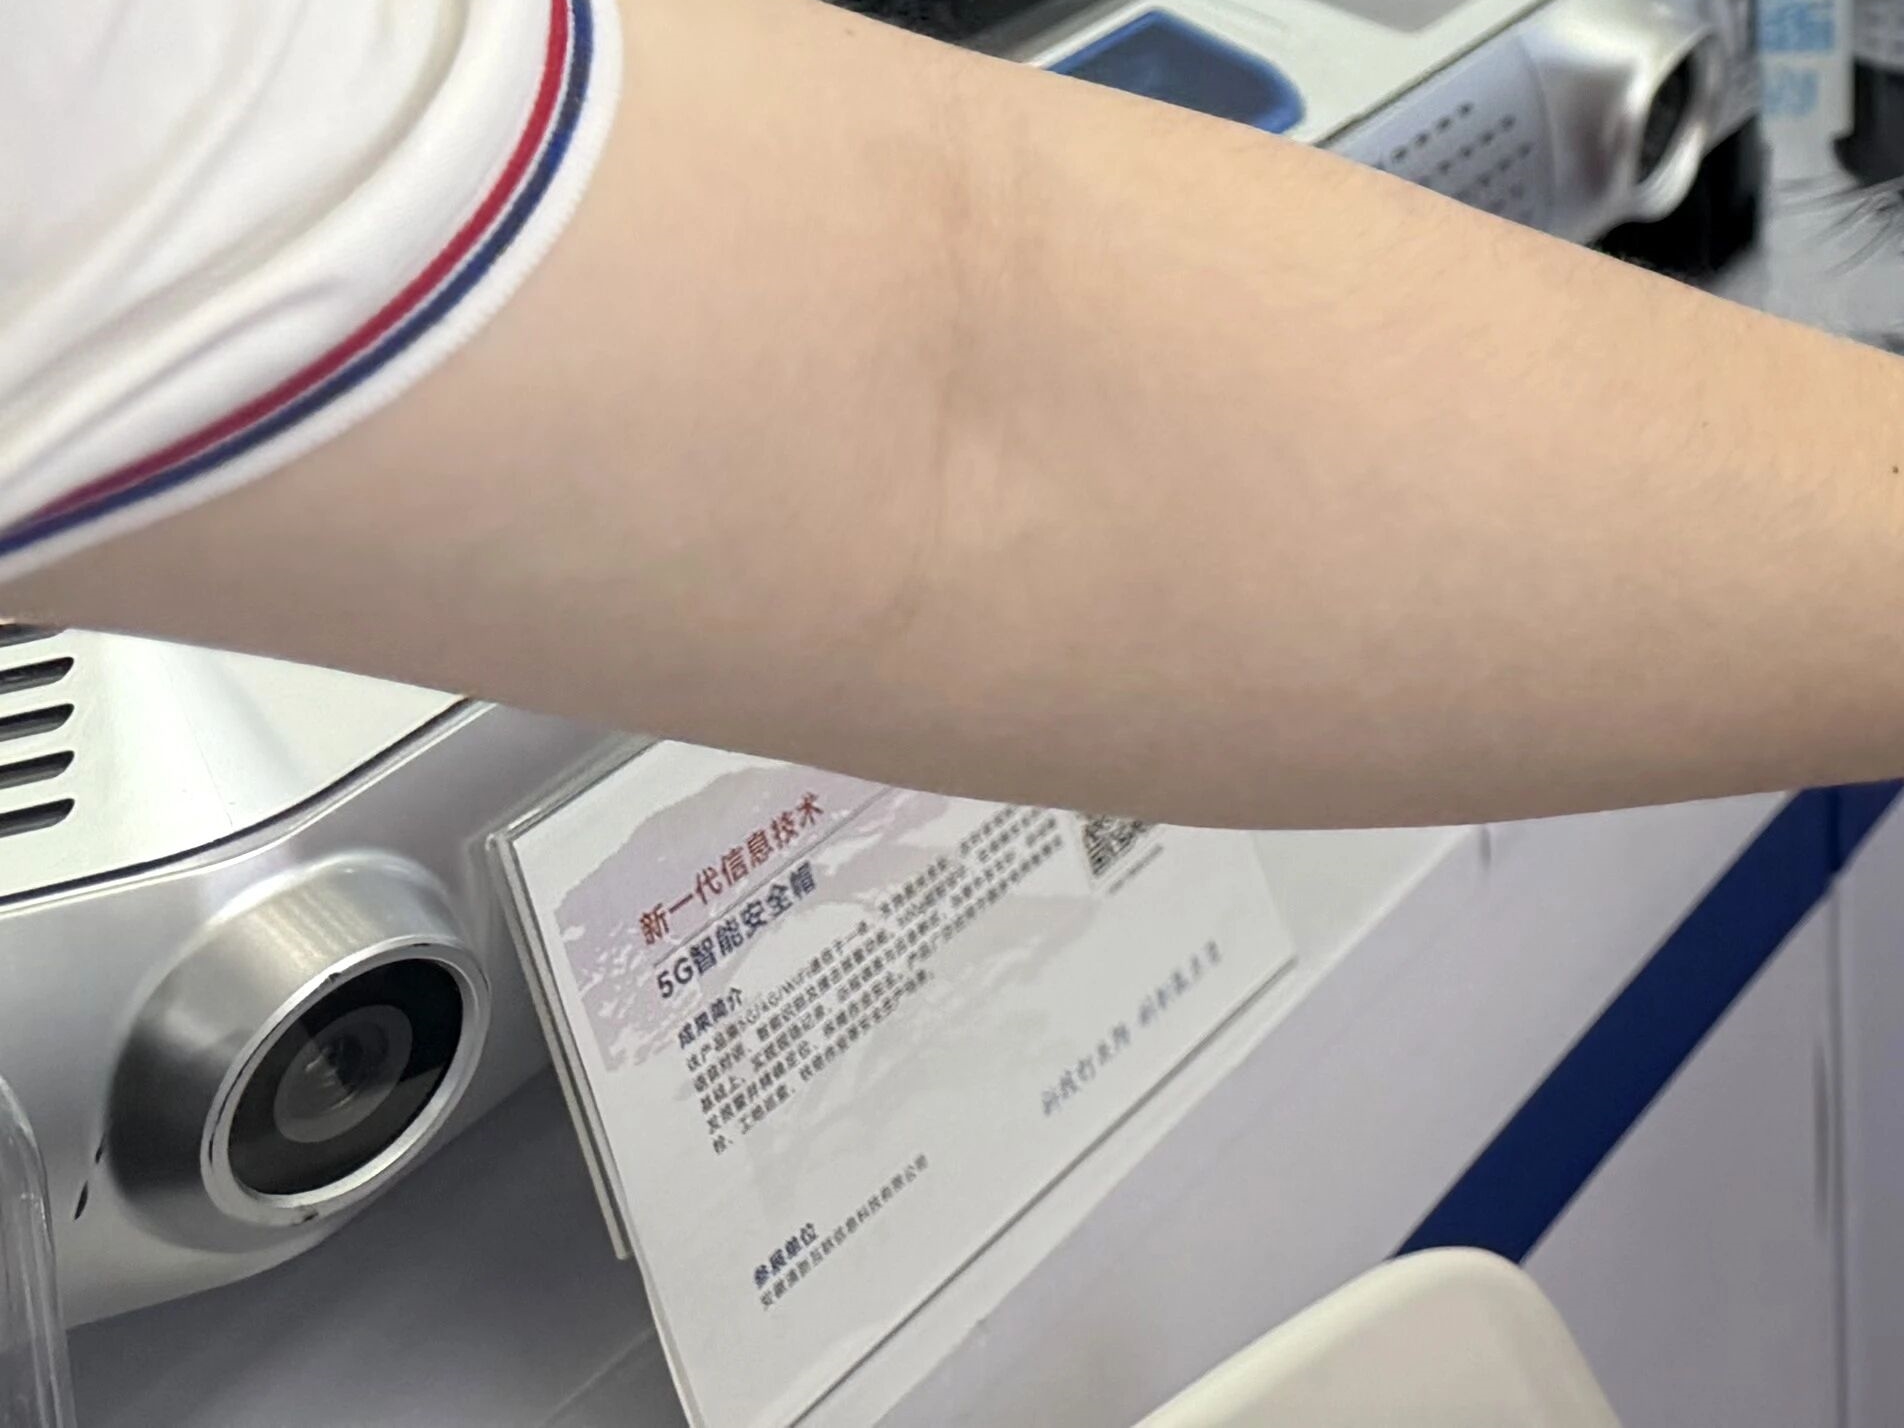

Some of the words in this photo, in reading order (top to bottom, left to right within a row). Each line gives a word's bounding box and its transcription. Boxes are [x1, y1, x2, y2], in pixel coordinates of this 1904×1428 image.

[639, 792, 824, 946] 新一代信息技术
[656, 860, 817, 999] 5G智能安全帽
